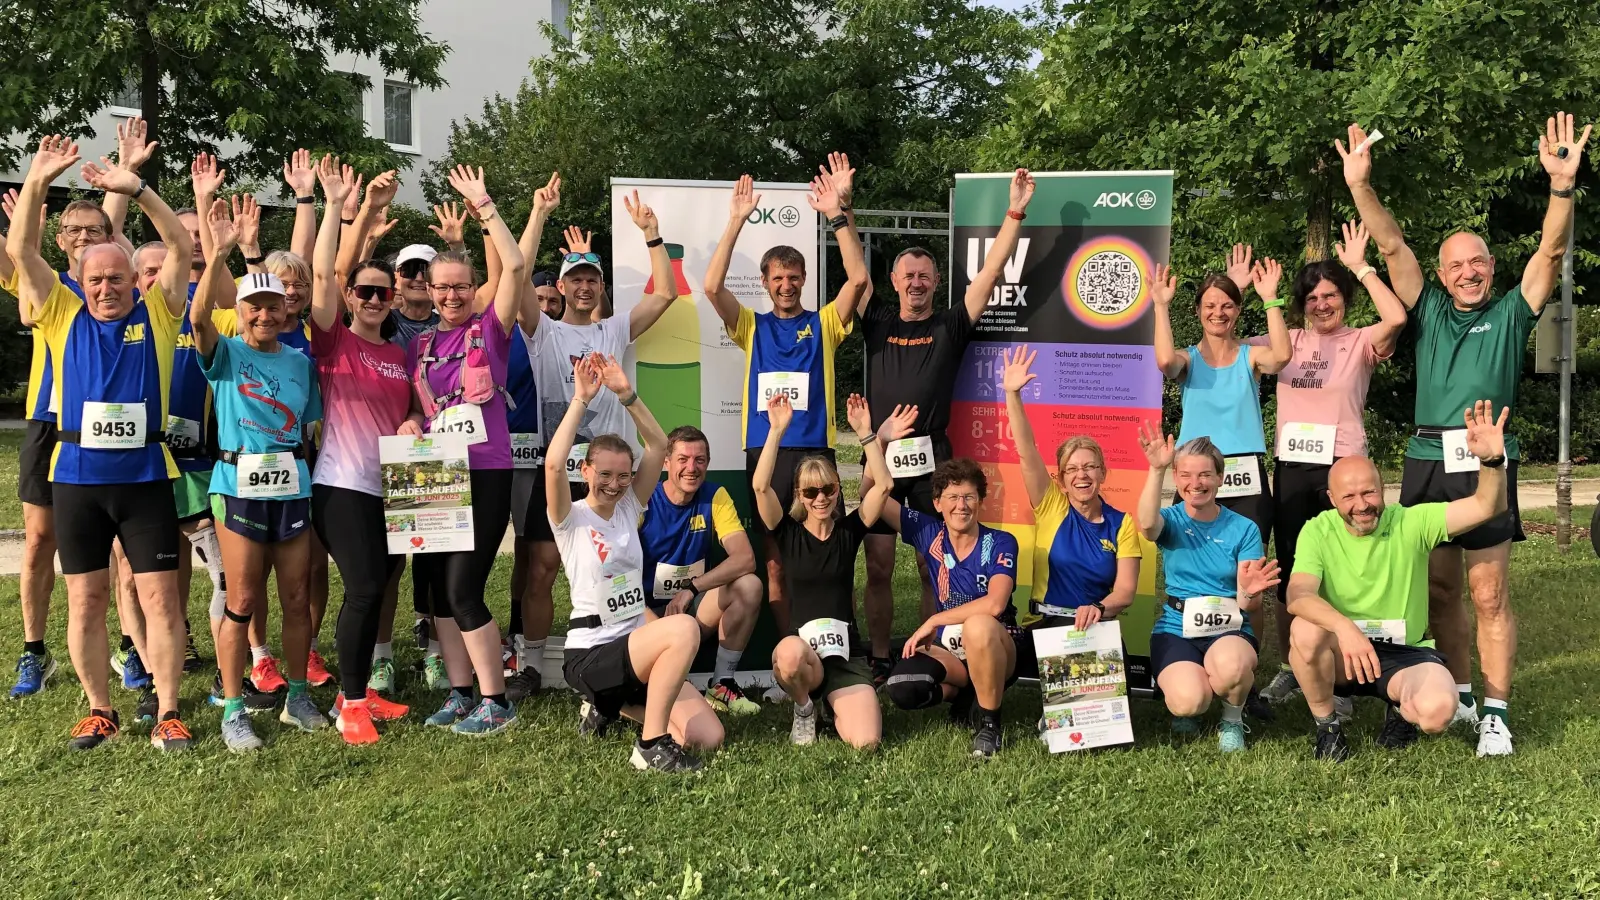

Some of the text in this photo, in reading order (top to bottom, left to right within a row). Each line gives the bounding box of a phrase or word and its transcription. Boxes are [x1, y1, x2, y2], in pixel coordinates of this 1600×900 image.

[1093, 192, 1134, 208] AOK
[747, 208, 776, 224] OK
[1106, 352, 1143, 361] notwendig
[1300, 361, 1328, 370] RUNNERS
[1291, 378, 1323, 388] BEAUTIFUL
[972, 406, 996, 416] SEHR
[1052, 412, 1140, 423] Schutz absolut notwendig
[92, 421, 136, 438] 9453
[165, 432, 192, 449] 454
[1288, 438, 1324, 453] 9465
[510, 448, 538, 460] 460
[893, 452, 927, 468] 9459
[1454, 446, 1475, 460] 94
[566, 458, 582, 472] 94
[249, 469, 290, 486] 9472
[1224, 472, 1252, 487] 466
[387, 484, 468, 497] TAG DES LAUFENS
[606, 587, 643, 612] 9452
[1194, 612, 1232, 626] 9467
[809, 632, 844, 650] 9458
[1045, 676, 1122, 692] TAG DES LAUFENS
